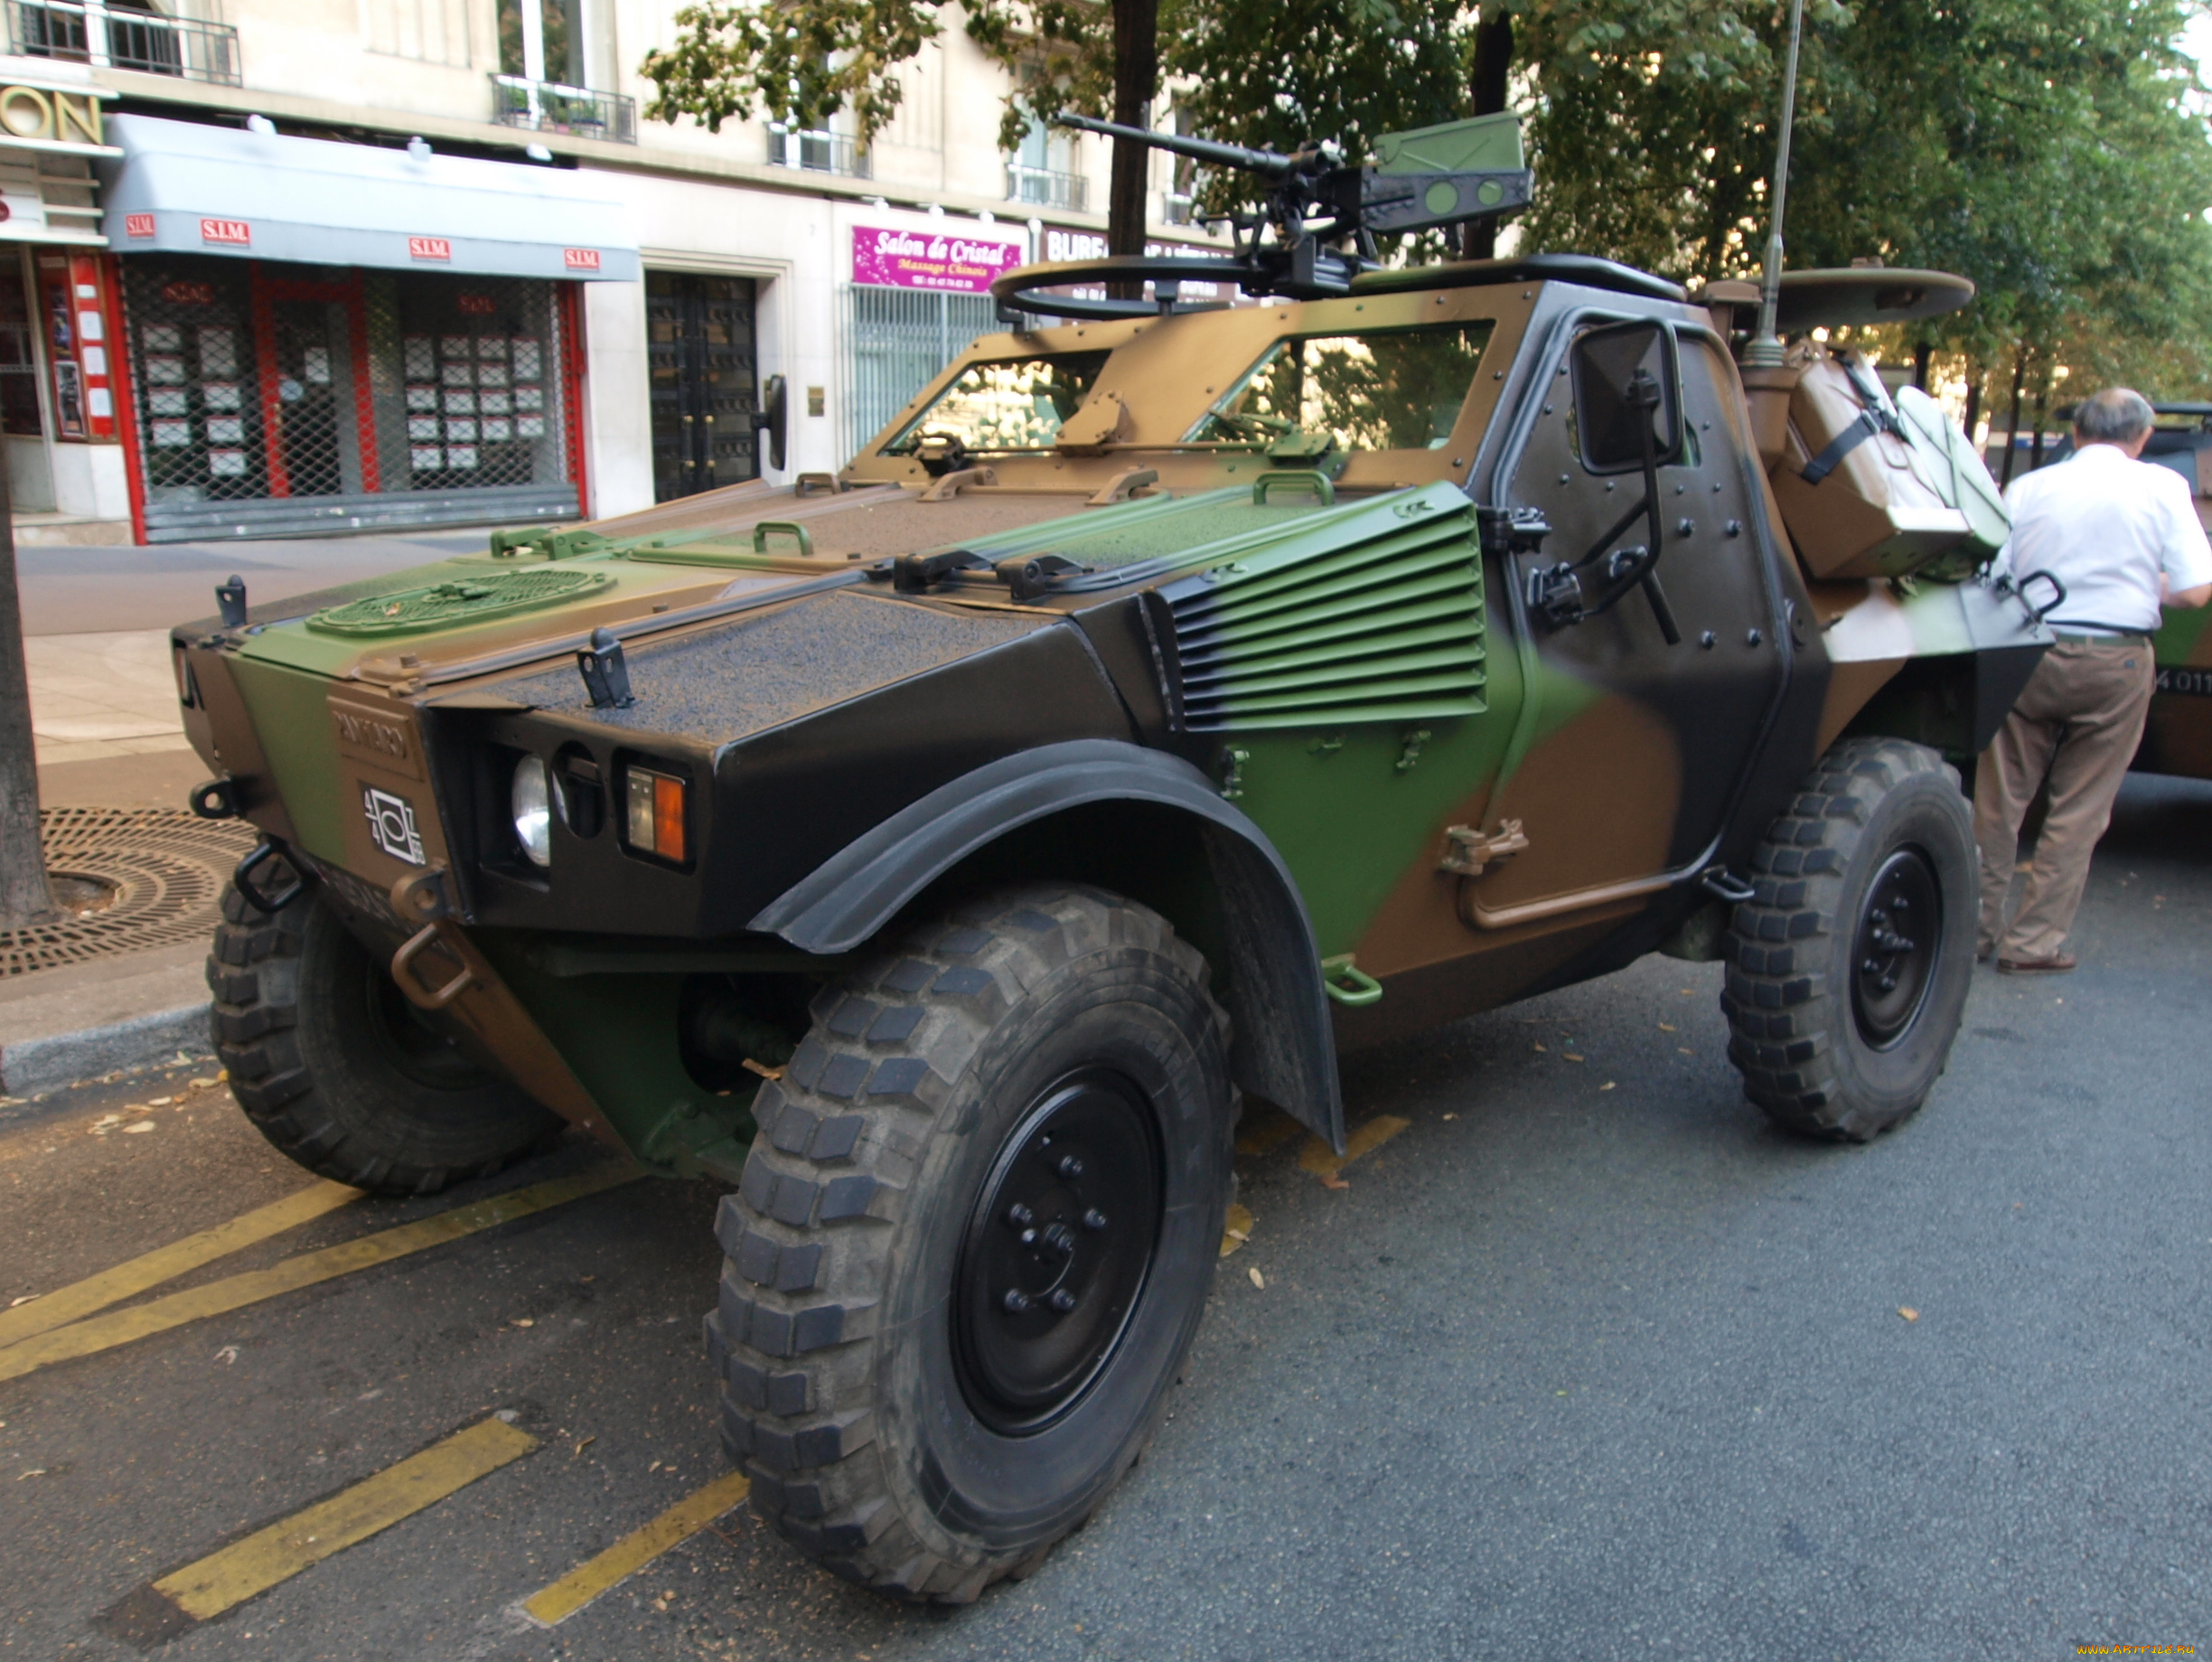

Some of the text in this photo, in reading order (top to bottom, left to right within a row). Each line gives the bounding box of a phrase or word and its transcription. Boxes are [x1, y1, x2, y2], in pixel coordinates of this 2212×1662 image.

[0, 85, 104, 146] ON
[127, 216, 154, 234] S.I.M.
[202, 220, 248, 241] S.I.M.
[411, 239, 449, 257] S.I.M.
[874, 230, 1008, 266] Salon de Cristal
[565, 249, 598, 267] S.I.M.
[897, 258, 989, 277] Massage Chinois
